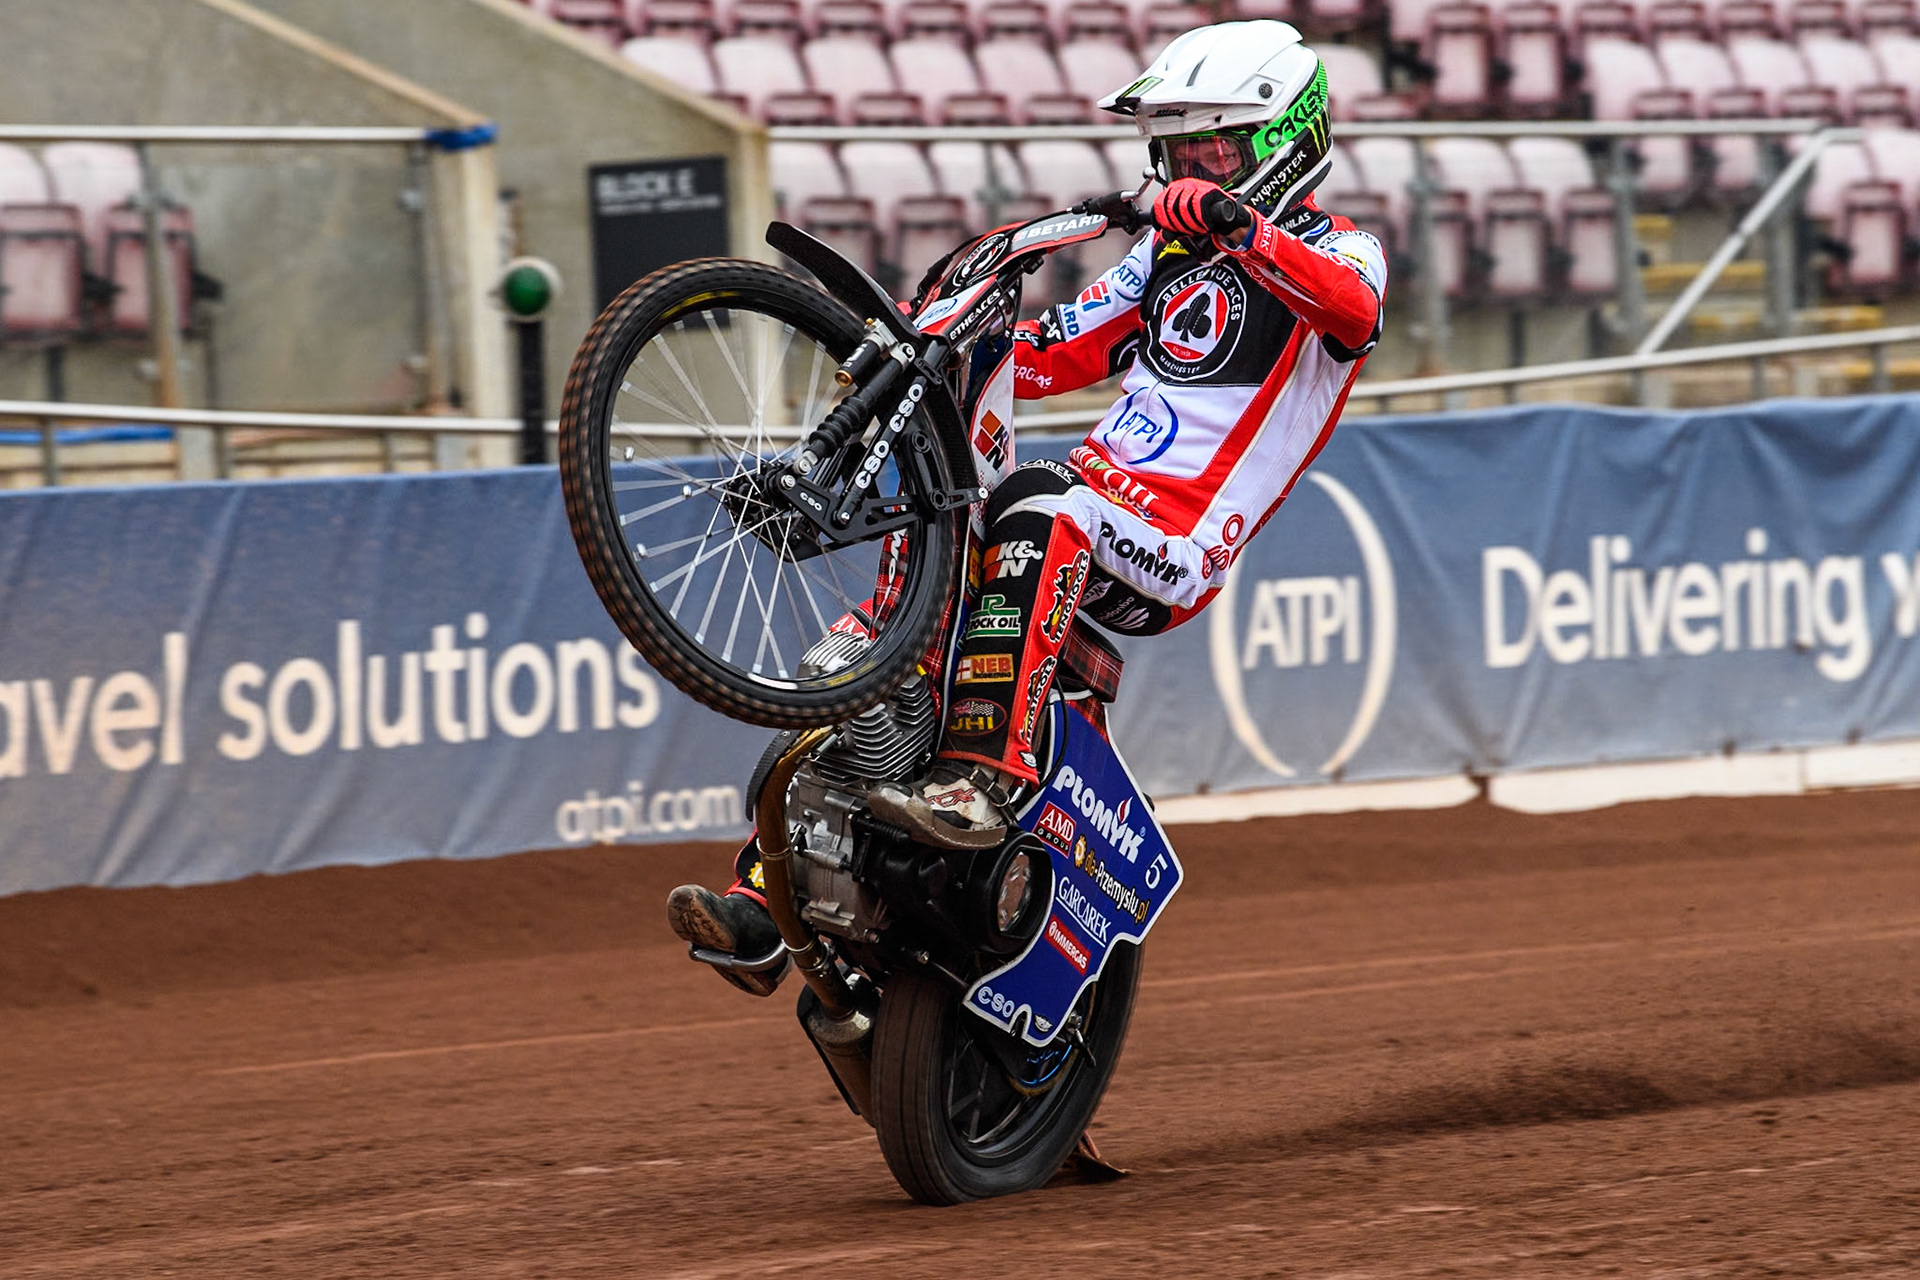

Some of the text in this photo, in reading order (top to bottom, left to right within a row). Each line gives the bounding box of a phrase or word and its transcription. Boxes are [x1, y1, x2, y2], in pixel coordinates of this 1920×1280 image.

[1264, 82, 1322, 148] OAKLEY
[1250, 150, 1307, 207] MONSTER
[1026, 214, 1105, 239] BETARD
[1280, 211, 1311, 231] ANLAS
[1162, 270, 1205, 302] BELLE
[1227, 286, 1241, 321] ACES
[1119, 411, 1163, 444] ATPI
[996, 540, 1044, 561] K&
[996, 559, 1029, 578] N
[1483, 527, 1872, 682] Delivering
[970, 617, 1019, 630] ROCK OIL
[1242, 576, 1361, 671] ATPI
[972, 657, 1010, 672] NEB
[217, 612, 661, 761] solutions
[950, 716, 994, 731] JHI
[556, 780, 743, 844] atpi.com
[1040, 809, 1074, 842] AMD
[1037, 827, 1070, 853] GROUP
[1145, 853, 1168, 889] 5
[1058, 876, 1111, 943] GARCAREK
[1054, 928, 1087, 970] IMMERGAS
